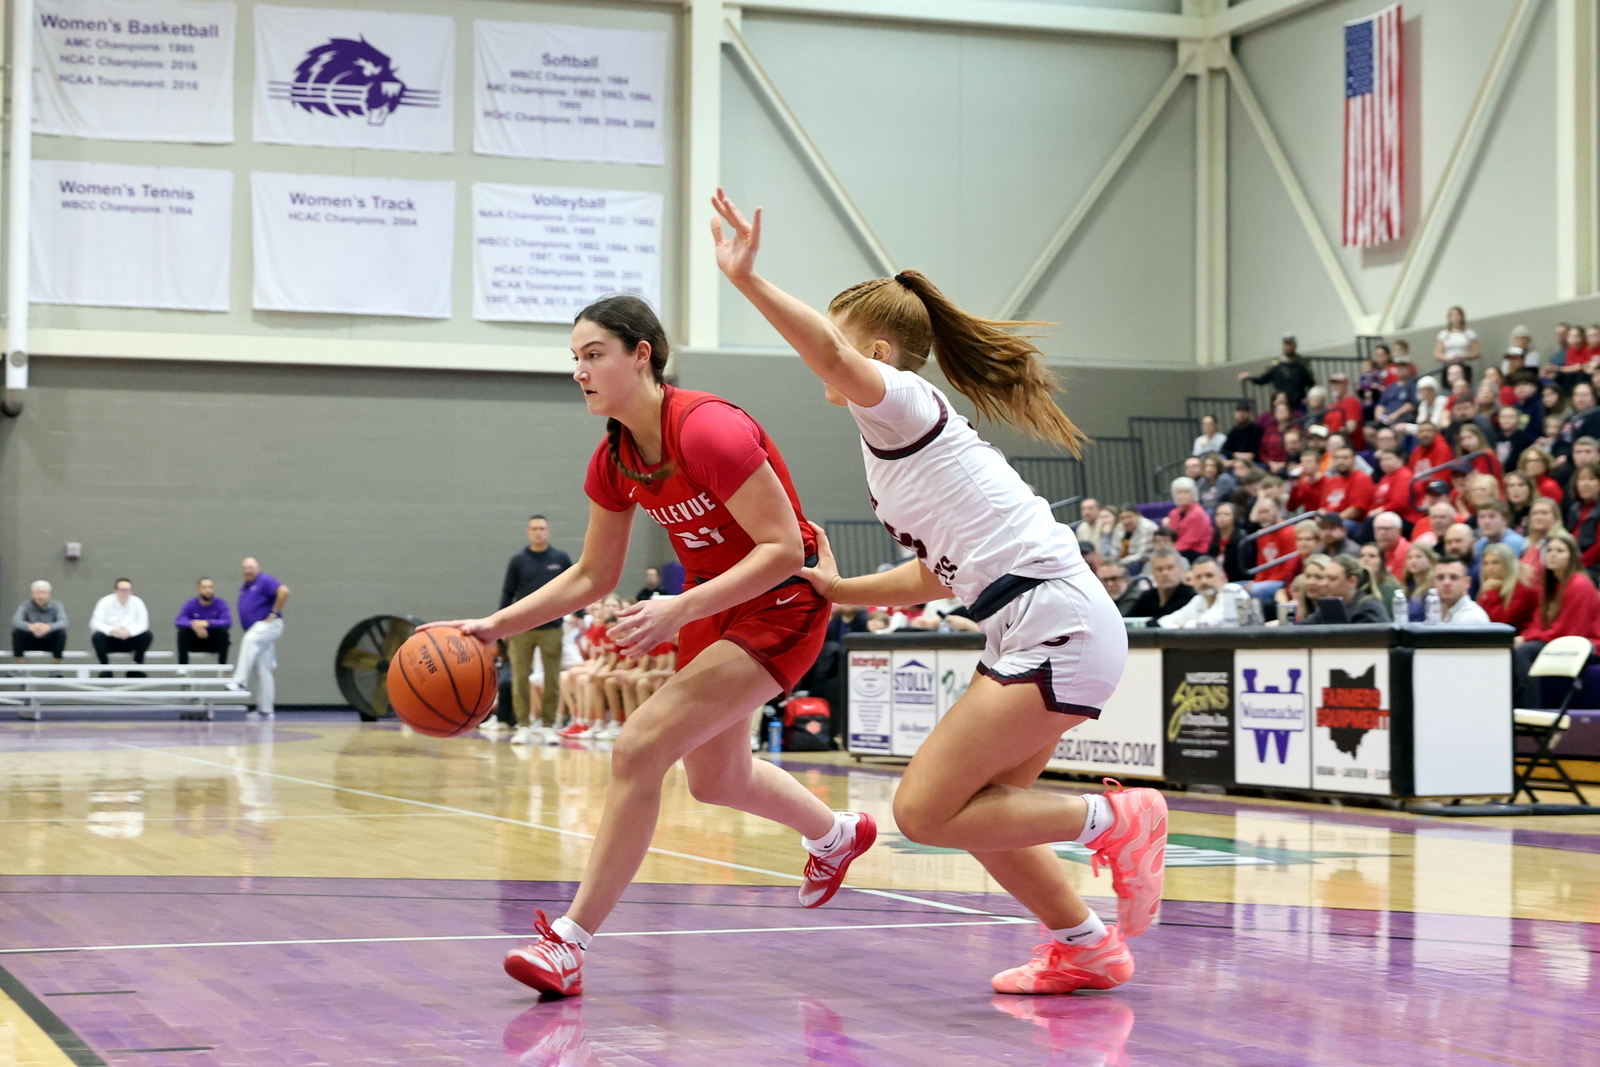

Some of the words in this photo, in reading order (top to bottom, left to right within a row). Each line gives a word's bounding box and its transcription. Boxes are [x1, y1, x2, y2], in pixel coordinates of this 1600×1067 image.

[40, 14, 121, 33] Women's
[128, 20, 219, 38] Basketball
[64, 38, 91, 49] AMC
[59, 54, 95, 66] HCAC
[171, 60, 198, 71] 2016
[541, 52, 599, 68] Softball
[172, 79, 198, 91] 2016
[59, 180, 136, 197] Women's
[141, 184, 194, 200] Tennis
[289, 192, 367, 209] Women's
[371, 195, 416, 210] Track
[533, 193, 606, 211] Volleyball
[645, 491, 717, 525] ELLEVUE
[894, 672, 934, 691] STOLLY
